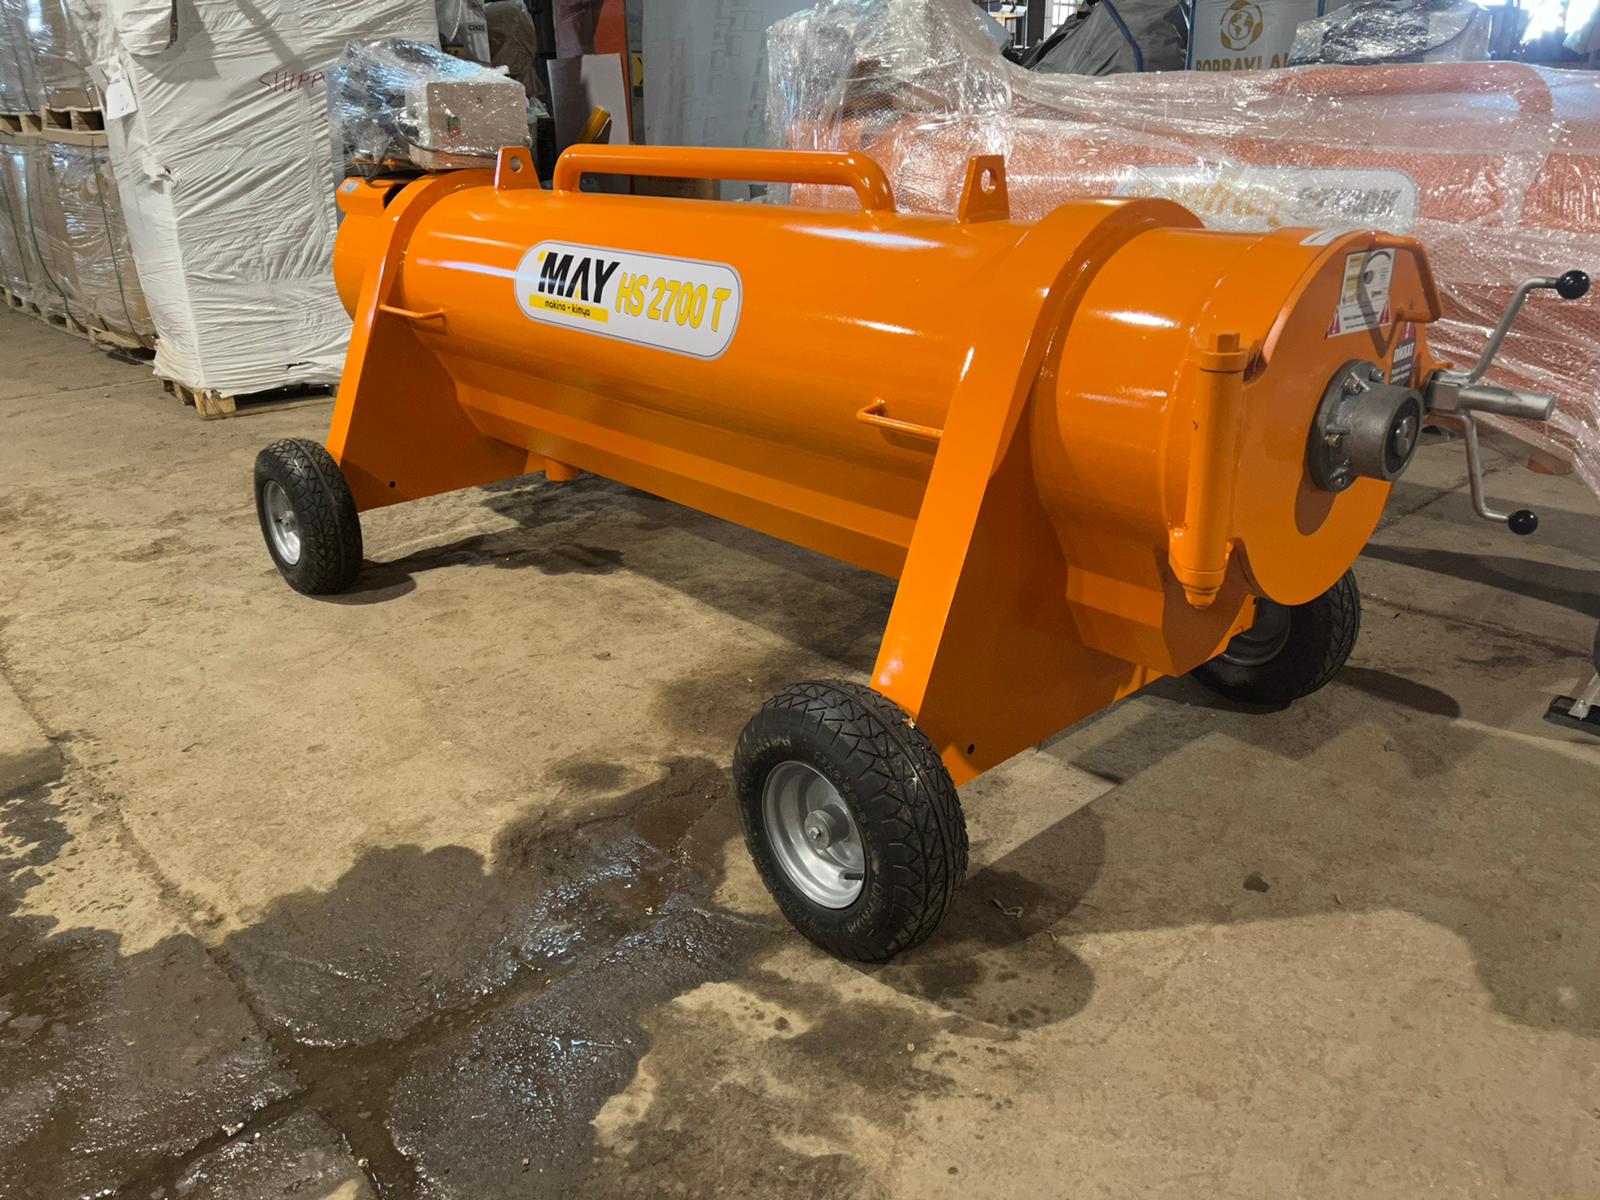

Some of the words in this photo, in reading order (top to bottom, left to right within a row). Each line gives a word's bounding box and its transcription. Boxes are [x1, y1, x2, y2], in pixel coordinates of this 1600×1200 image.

[538, 251, 621, 304] MAY
[615, 271, 648, 317] HS
[647, 277, 708, 330] 2700
[711, 288, 732, 333] T
[545, 299, 567, 312] makina
[571, 303, 591, 318] kimya
